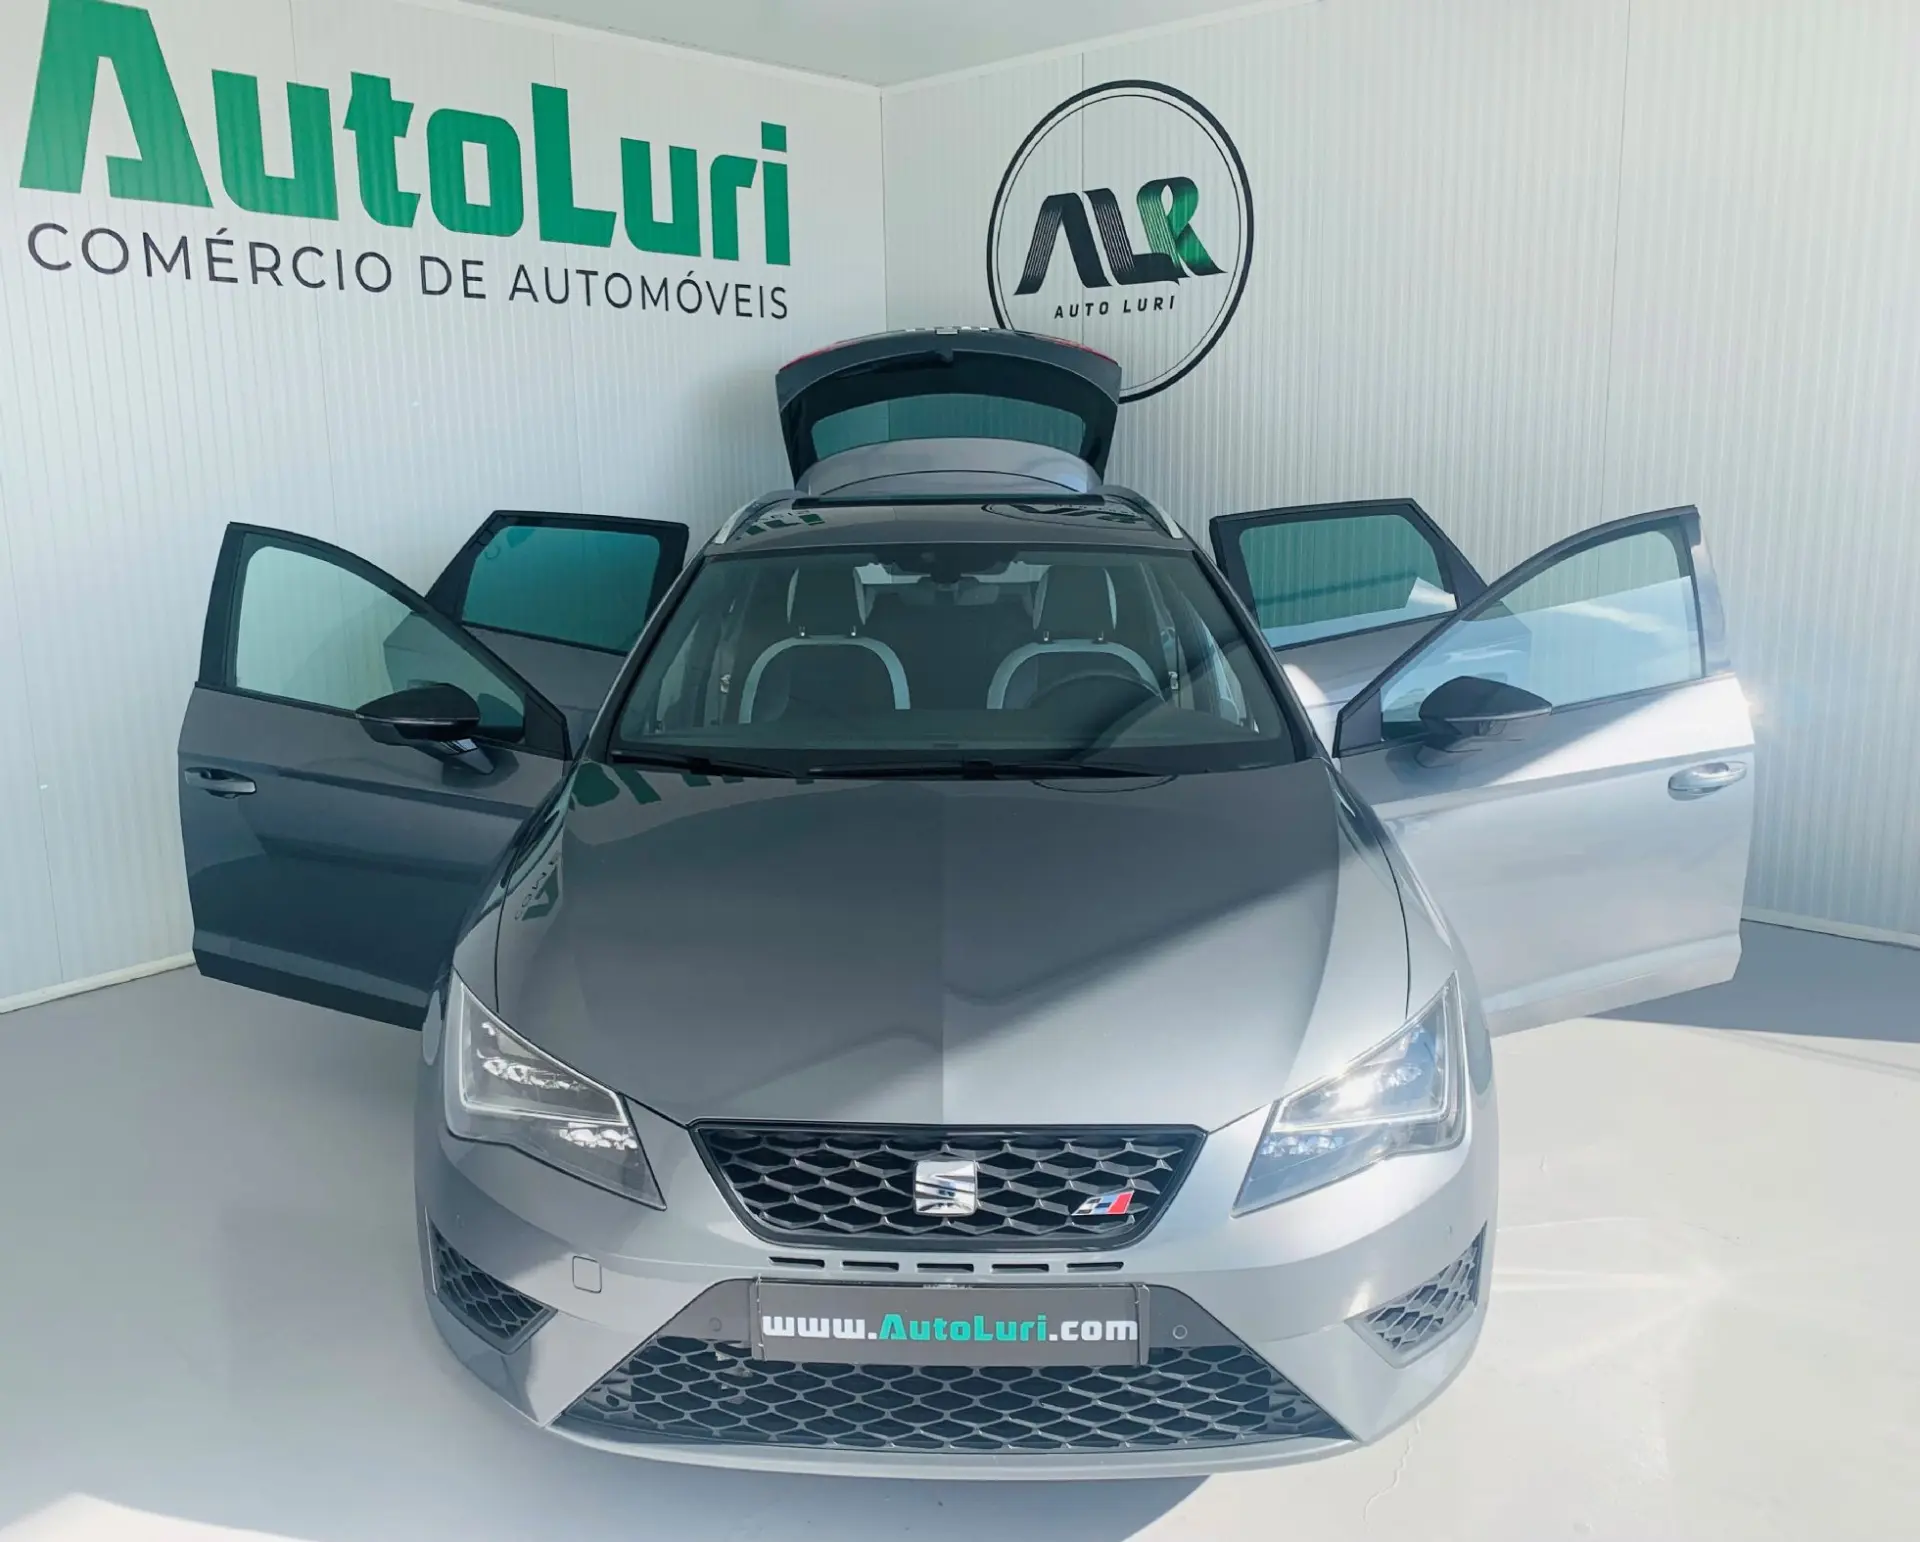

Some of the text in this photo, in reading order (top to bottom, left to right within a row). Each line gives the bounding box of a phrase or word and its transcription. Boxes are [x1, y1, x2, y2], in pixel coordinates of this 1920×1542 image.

[20, 0, 791, 266] AutoLuri
[27, 222, 788, 320] COMÉRCIO DE AUTOMÓVEIS
[1054, 295, 1176, 319] AUTO LURI
[762, 1313, 1138, 1342] www.AutoLuri.com
